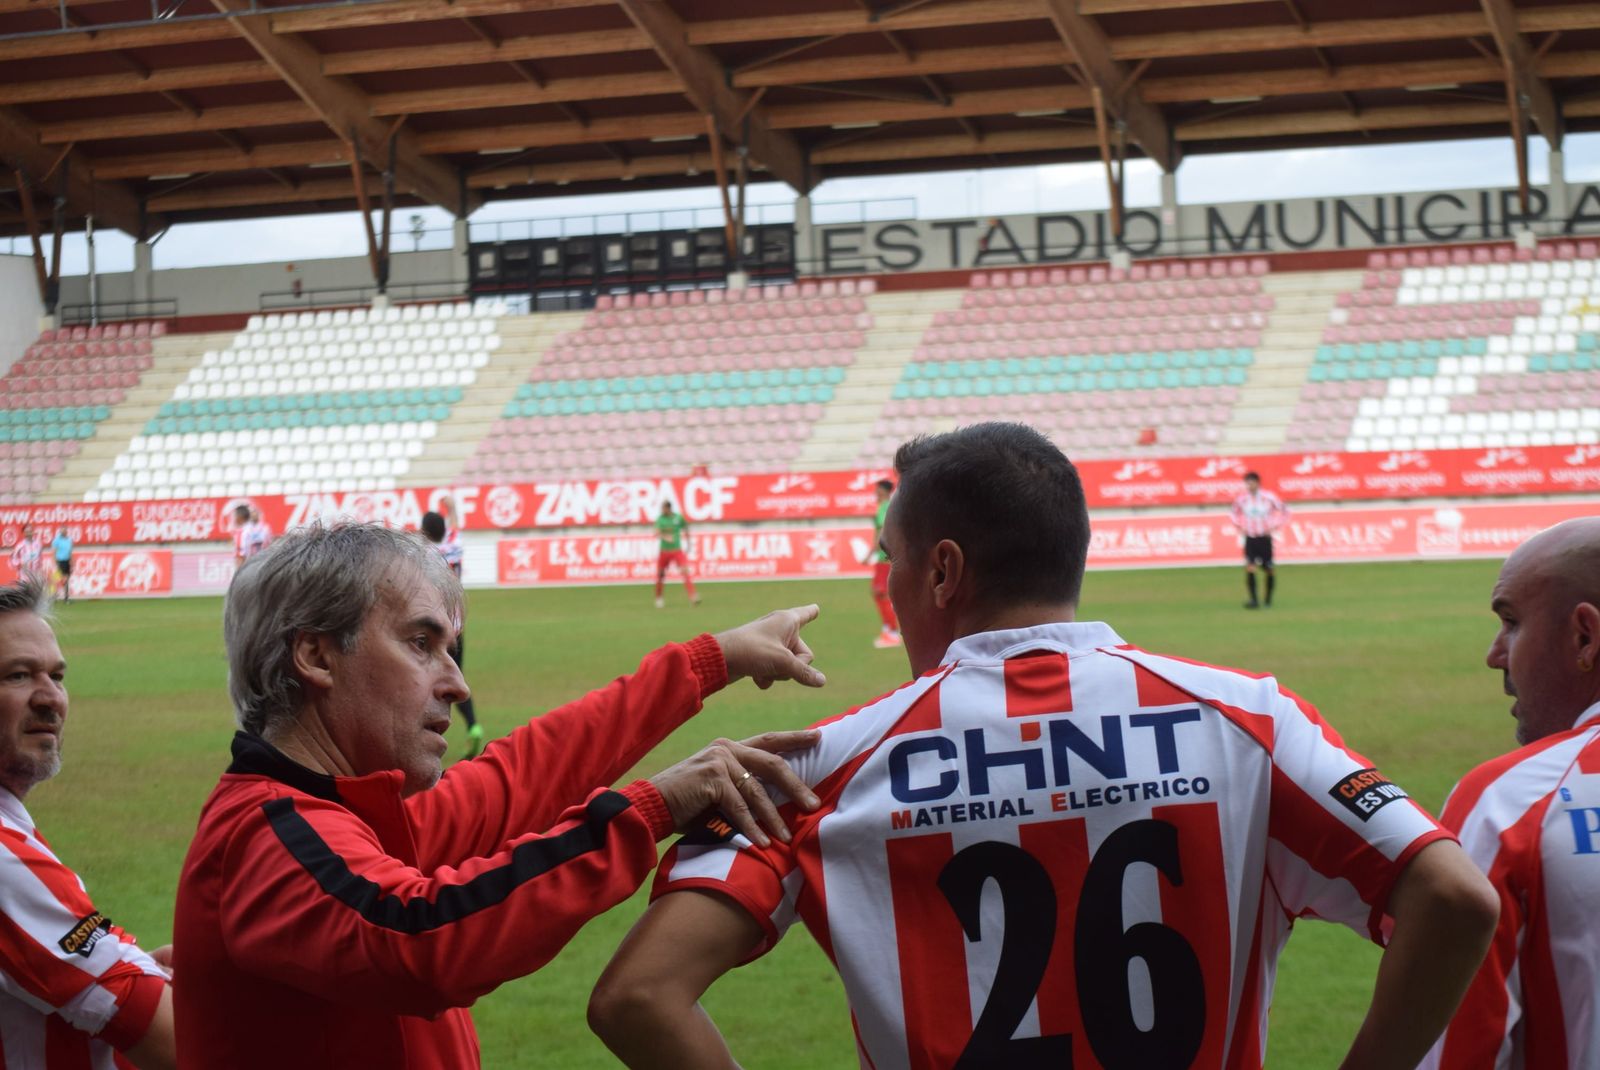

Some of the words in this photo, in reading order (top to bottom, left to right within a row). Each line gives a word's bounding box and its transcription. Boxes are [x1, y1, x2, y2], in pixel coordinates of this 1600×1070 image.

[821, 210, 1162, 274] ESTADIO
[533, 479, 682, 525] ZAMORA
[683, 476, 738, 520] CF
[587, 537, 660, 564] CAMIN
[703, 535, 728, 560] LA
[732, 532, 793, 559] PLATA
[891, 798, 1034, 830] MATERIAL
[1051, 776, 1210, 812] ELECTRICO
[1355, 791, 1383, 814] ES
[936, 818, 1207, 1070] 26
